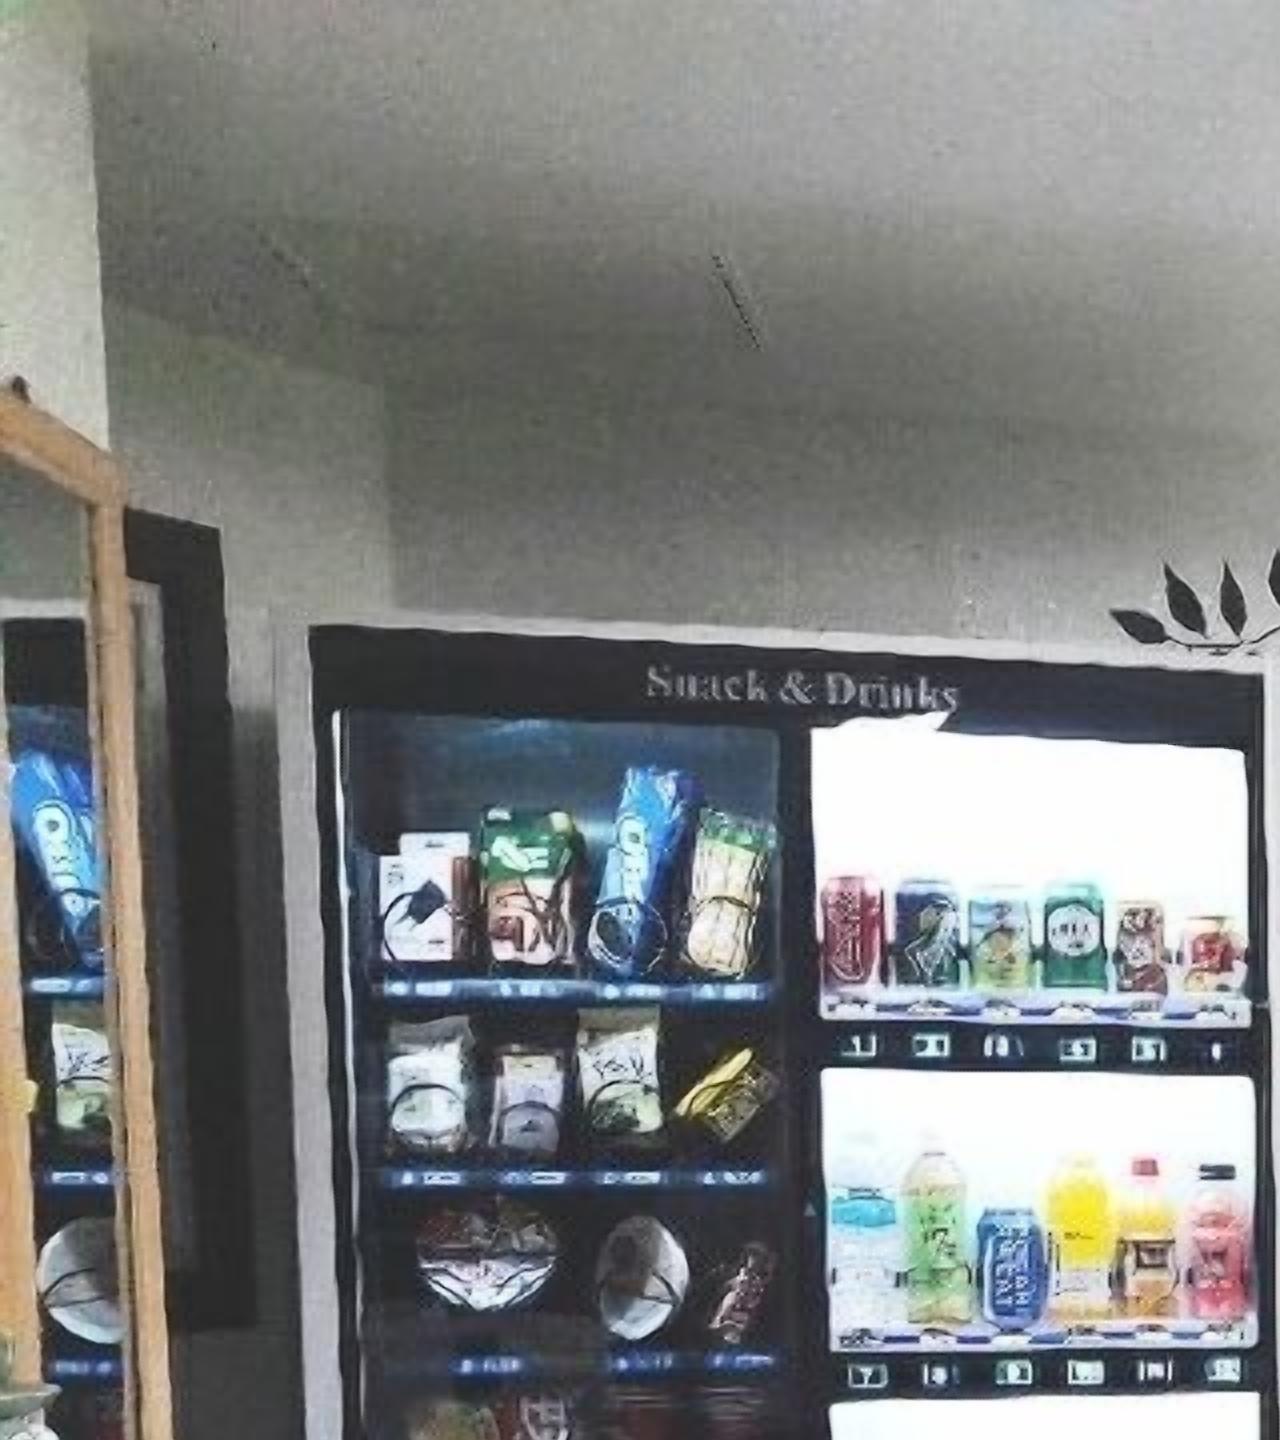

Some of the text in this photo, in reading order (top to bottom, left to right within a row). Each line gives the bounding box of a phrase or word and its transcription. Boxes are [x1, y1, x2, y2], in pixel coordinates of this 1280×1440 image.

[648, 663, 959, 714] Snack & Drinks
